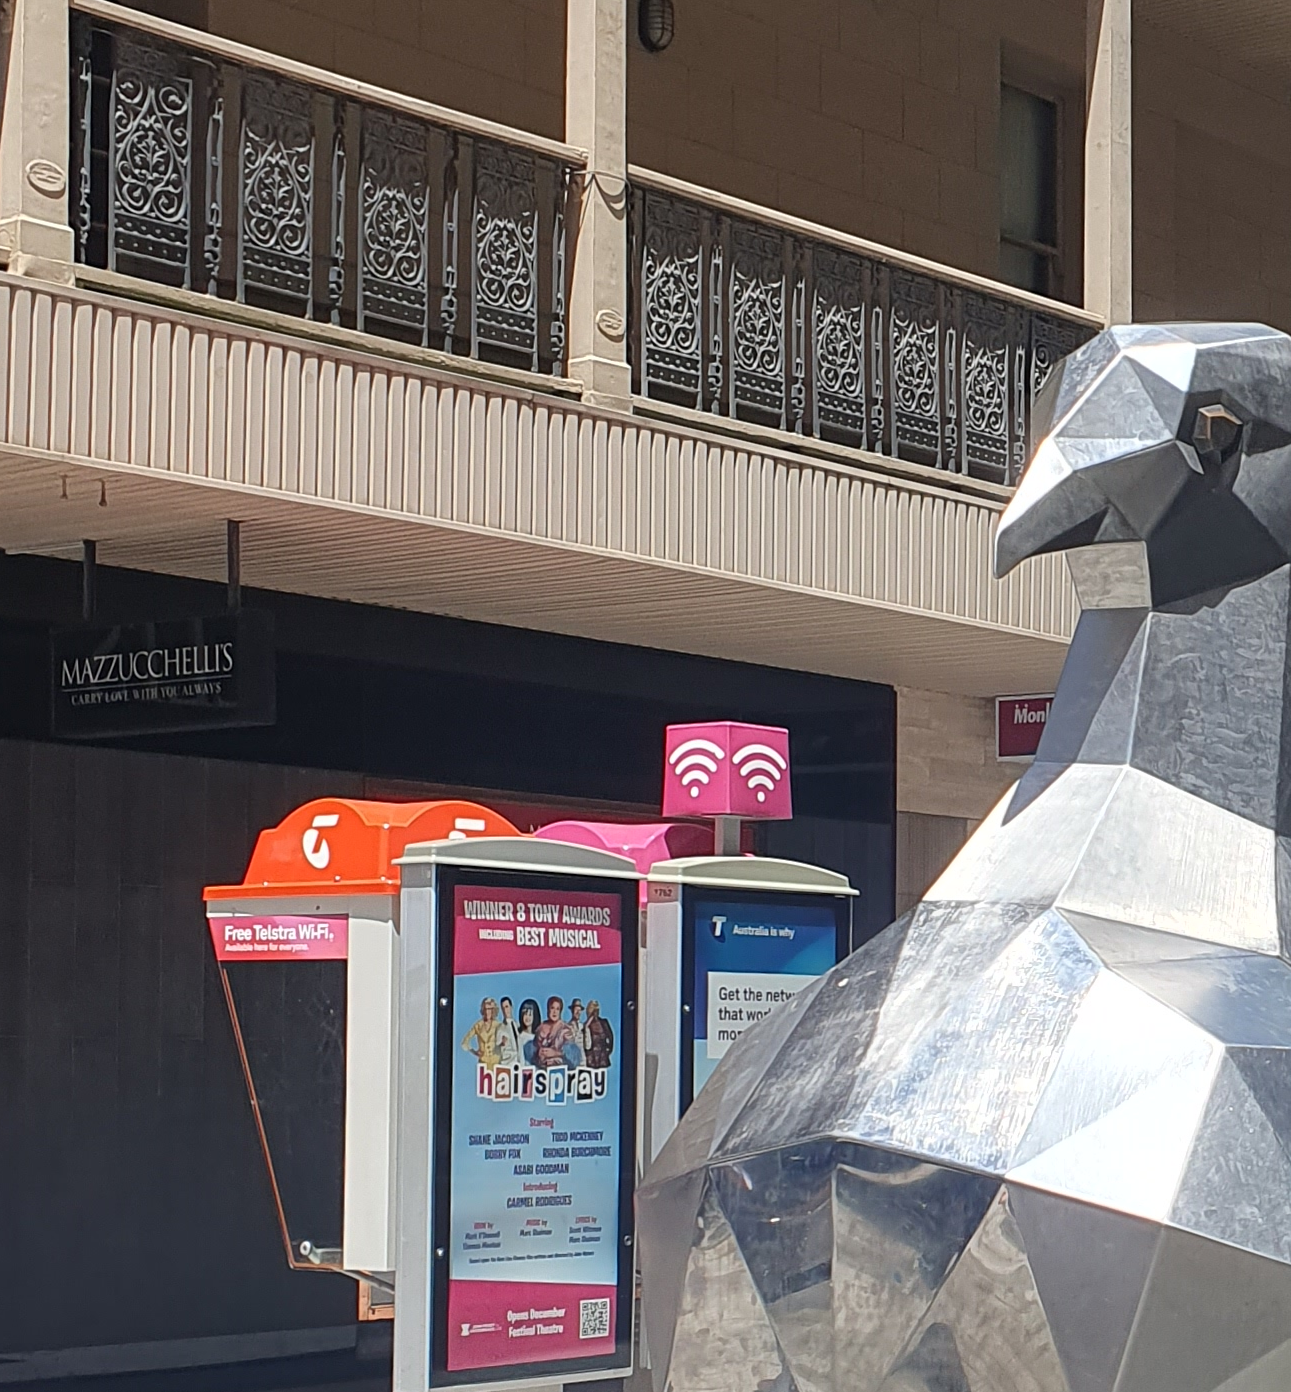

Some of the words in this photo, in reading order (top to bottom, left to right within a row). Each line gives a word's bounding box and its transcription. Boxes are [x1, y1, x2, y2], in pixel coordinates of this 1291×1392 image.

[62, 642, 233, 687] MAZZUCCHELLI'S
[71, 694, 103, 706] CARRY
[105, 690, 129, 703] LOVE
[133, 686, 158, 700] WITH
[160, 686, 181, 698] YOU
[182, 682, 222, 697] ALWAYS
[464, 900, 515, 922] WINNER
[516, 902, 526, 922] 8
[528, 903, 560, 924] TONY
[562, 905, 611, 926] AWARDS
[225, 925, 252, 941] Free
[253, 924, 297, 941] Telstra
[516, 926, 545, 947] BEST
[548, 928, 601, 949] MUSICAL
[733, 925, 769, 937] Australia
[770, 926, 778, 937] is
[779, 928, 795, 940] why
[225, 943, 253, 951] Available
[254, 943, 268, 951] here
[269, 943, 278, 951] for
[718, 986, 740, 1001] Get
[743, 987, 763, 1002] the
[766, 989, 796, 1002] netw
[718, 1007, 743, 1021] that
[746, 1008, 771, 1021] wor
[478, 1063, 607, 1105] hairspray
[529, 1117, 554, 1129] Starring
[508, 1148, 521, 1159] FOX
[523, 1181, 557, 1193] Introducing
[507, 1197, 533, 1209] CARMEL
[507, 1310, 529, 1324] Opens
[530, 1307, 566, 1320] December
[537, 1324, 563, 1335] Theatre
